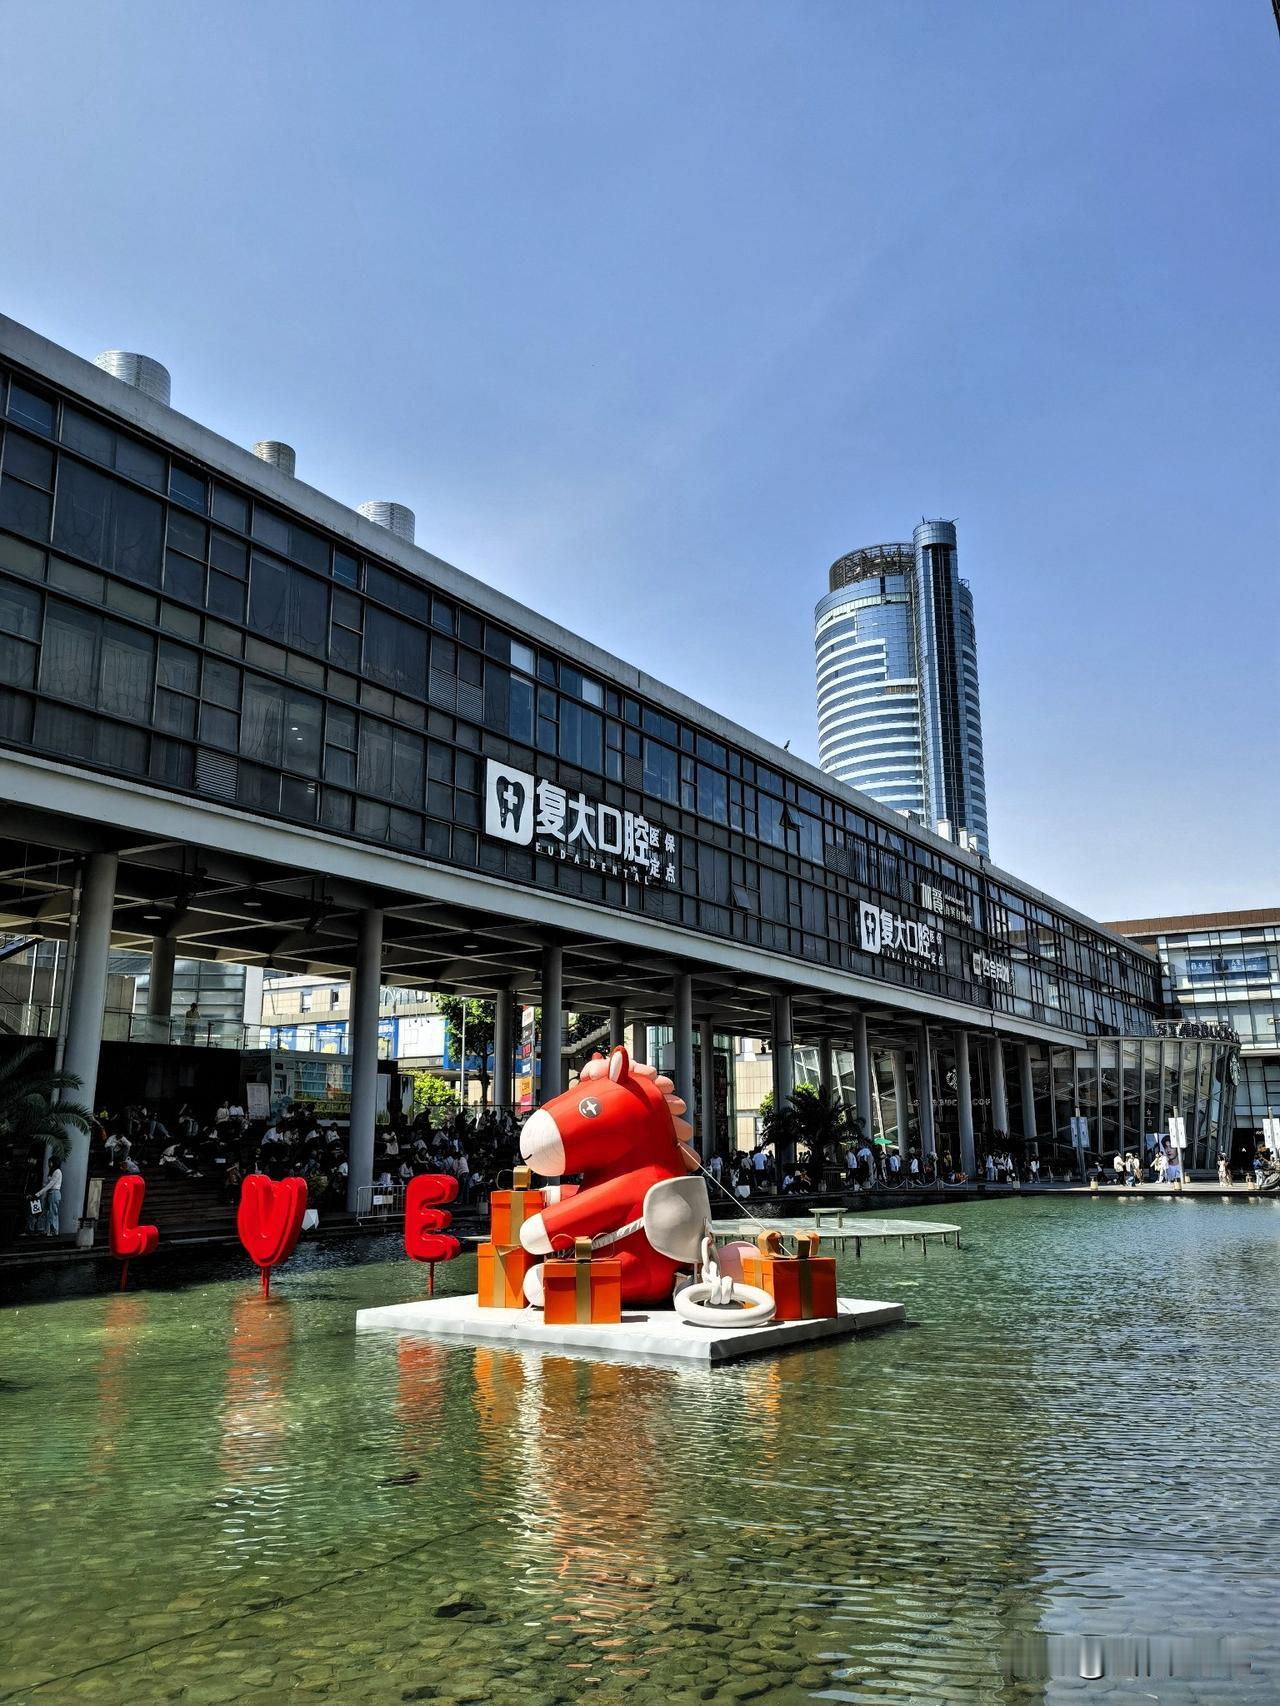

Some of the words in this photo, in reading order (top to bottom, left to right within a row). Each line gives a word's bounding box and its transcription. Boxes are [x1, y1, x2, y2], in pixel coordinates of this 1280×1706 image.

[536, 779, 650, 866] 复大口腔
[649, 826, 676, 853] 医保
[649, 857, 676, 883] 定点
[880, 909, 931, 958] 复大口腔
